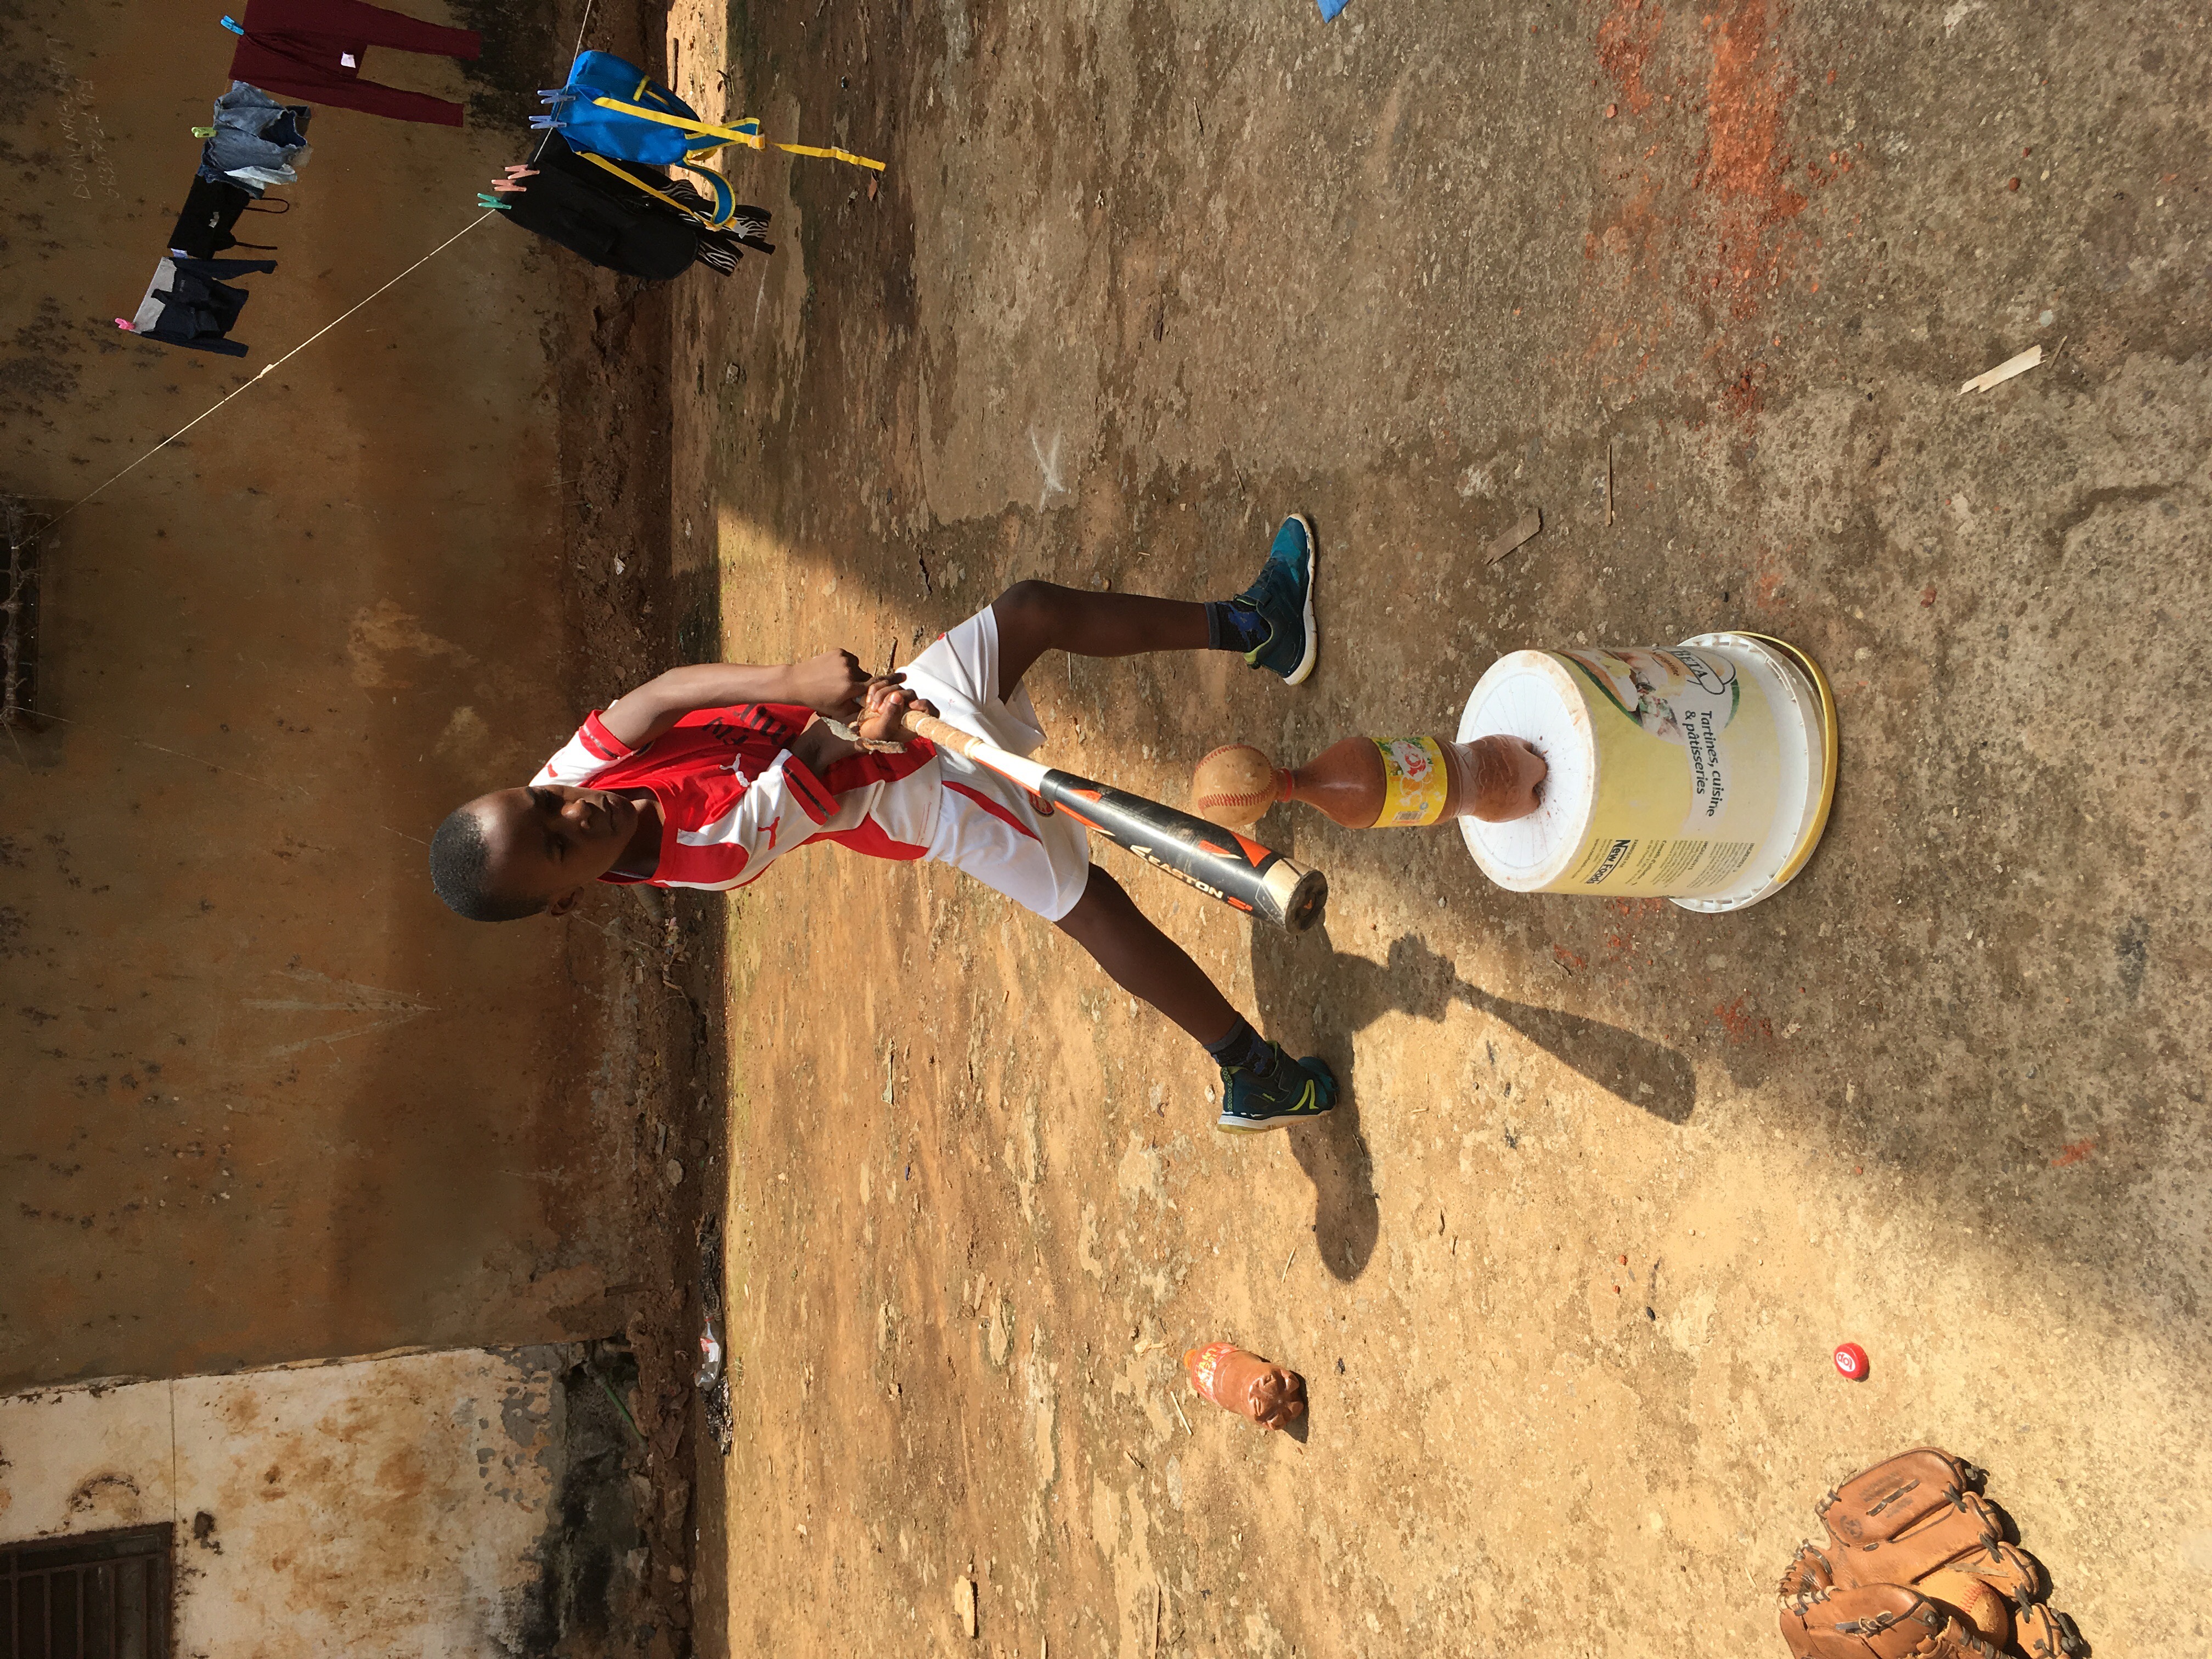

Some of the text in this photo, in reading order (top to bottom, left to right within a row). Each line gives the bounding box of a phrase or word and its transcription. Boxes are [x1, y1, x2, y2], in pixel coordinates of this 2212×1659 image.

[1673, 650, 1708, 679] BETA
[1682, 710, 1708, 795] & pâtisseries
[1701, 710, 1724, 817] Tartines, cuisine
[1605, 839, 1631, 861] New
[1148, 855, 1223, 899] EASTON
[1586, 865, 1614, 883] Foods
